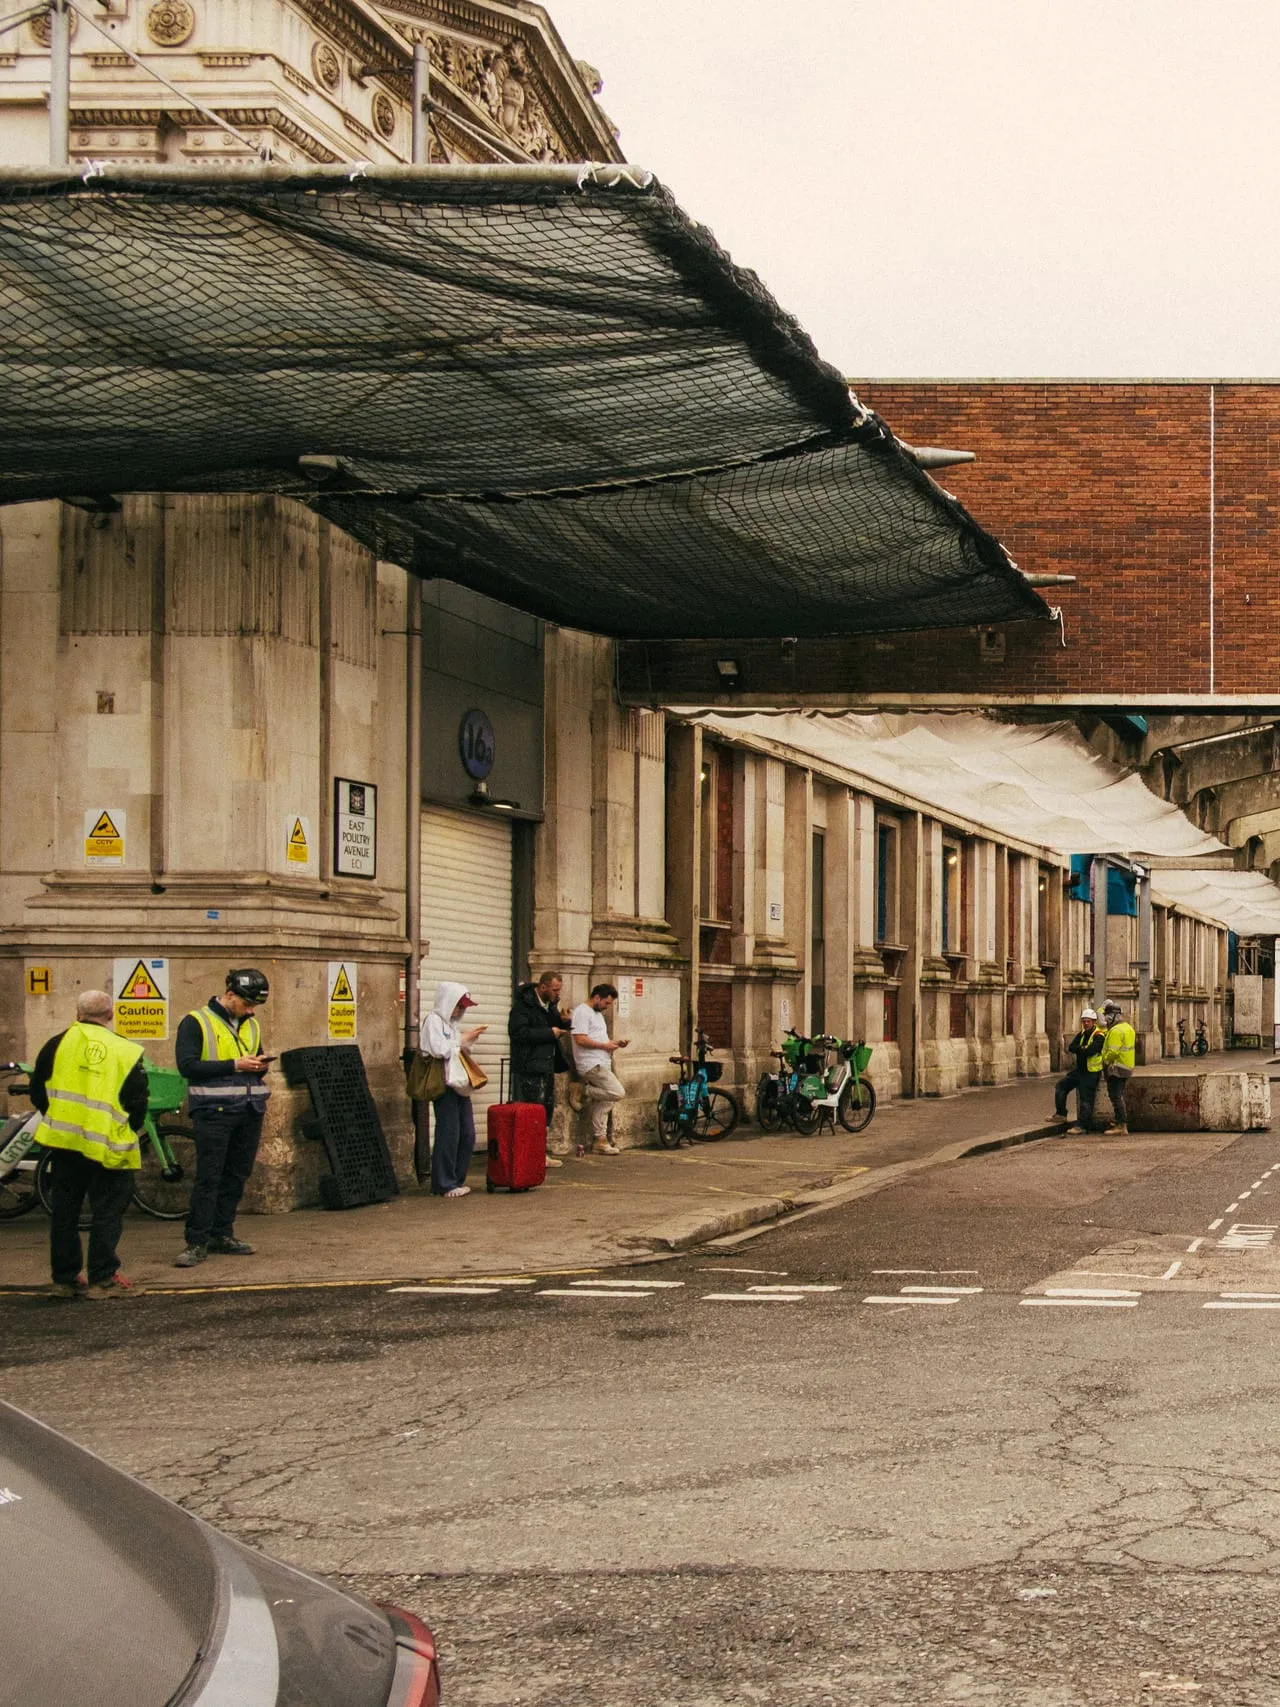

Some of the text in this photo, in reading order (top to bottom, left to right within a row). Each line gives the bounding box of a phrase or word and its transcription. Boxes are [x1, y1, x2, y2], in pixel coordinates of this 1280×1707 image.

[348, 820, 366, 832] EAST
[342, 831, 371, 845] POULTRY
[343, 845, 370, 858] AVENUE
[30, 970, 49, 992] H
[118, 1005, 164, 1016] Caution
[330, 1007, 355, 1017] Caution
[0, 1131, 33, 1163] Lime
